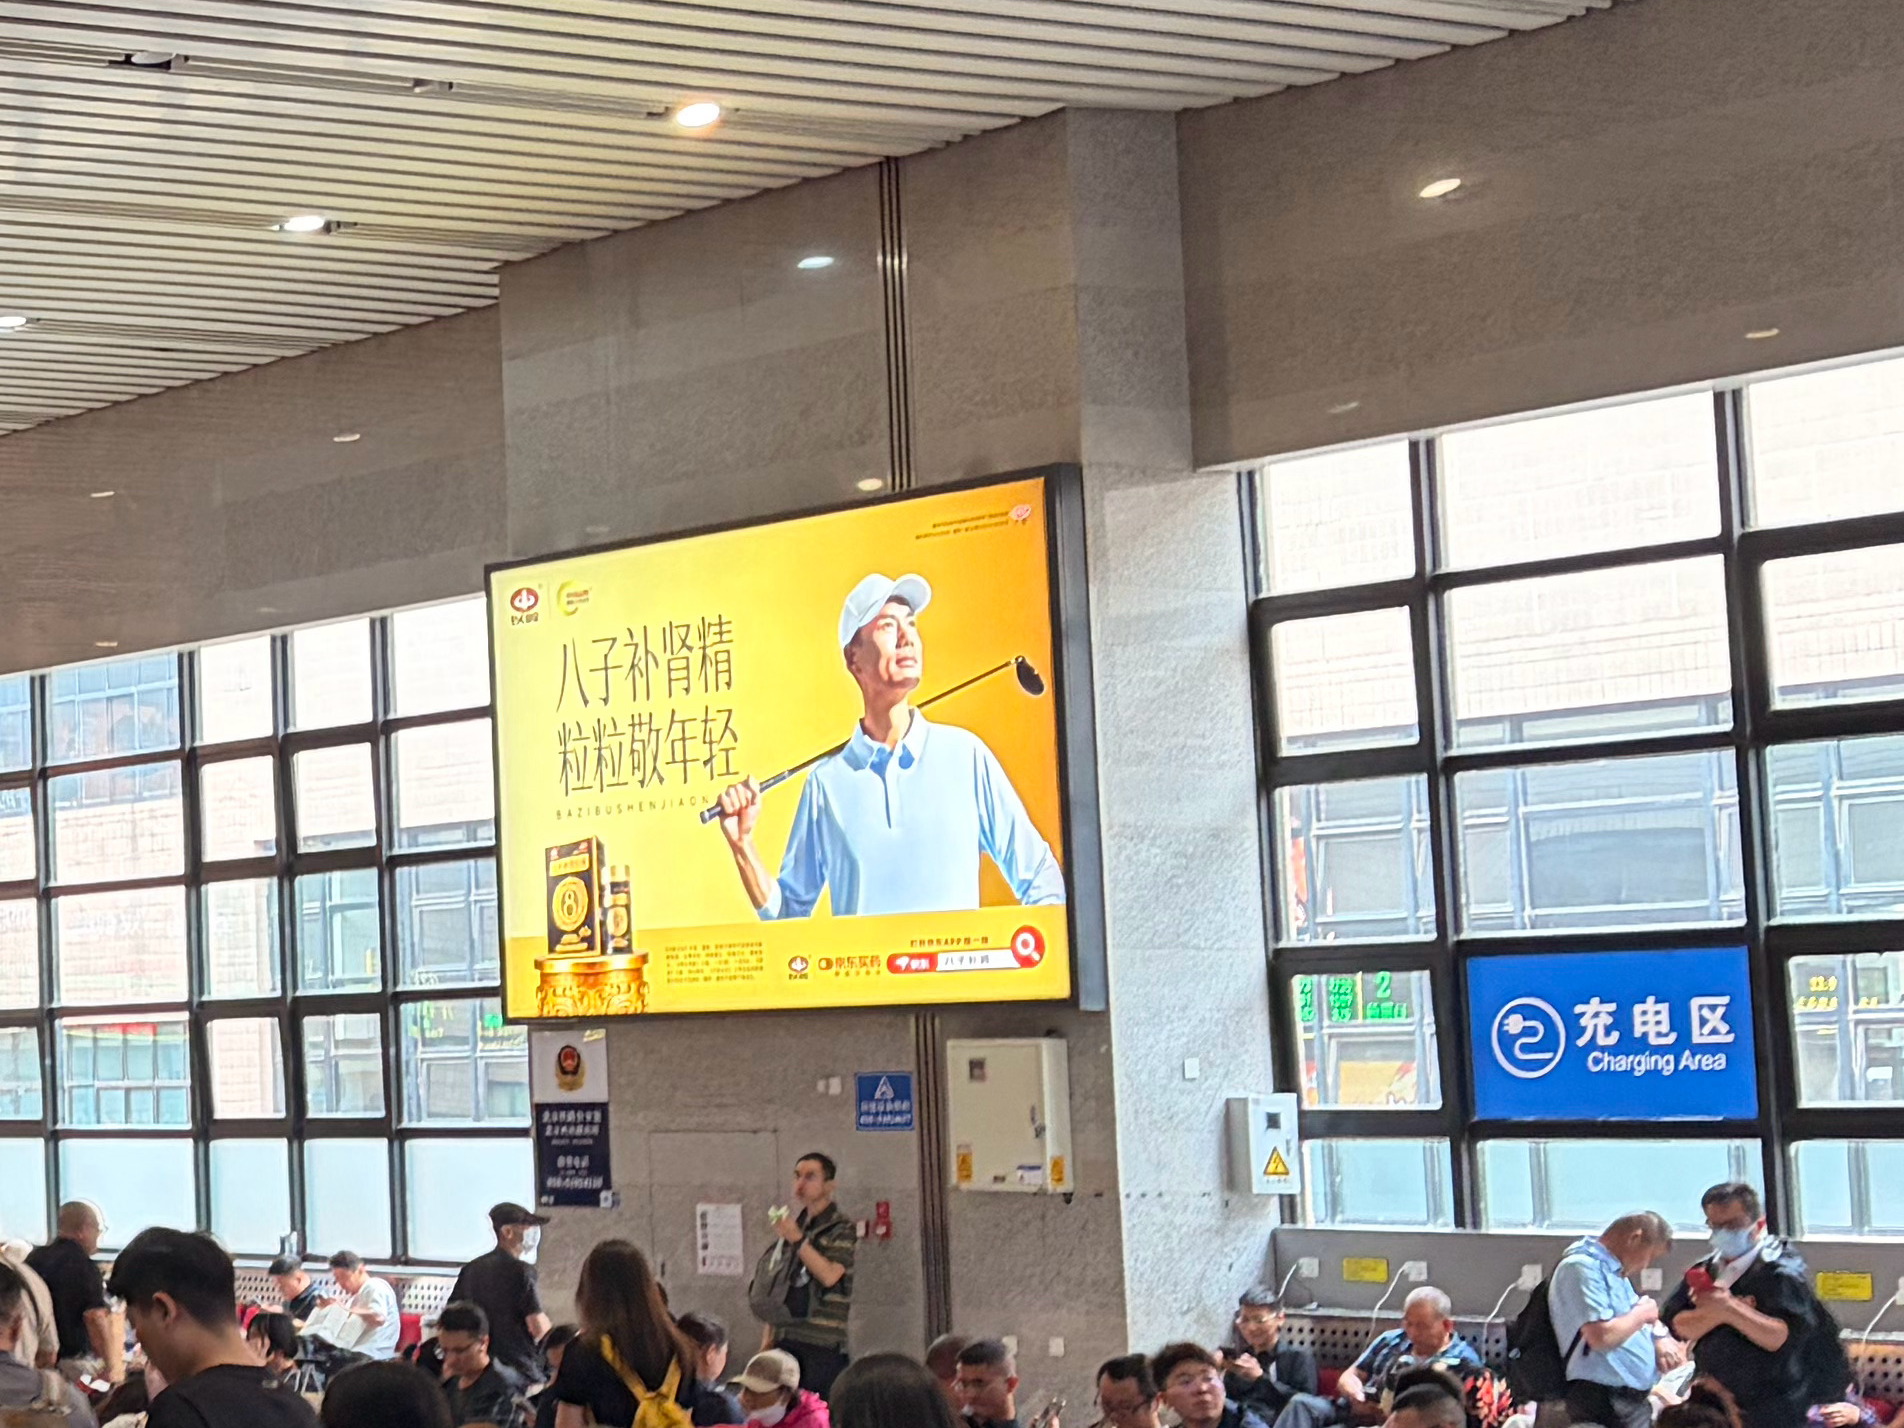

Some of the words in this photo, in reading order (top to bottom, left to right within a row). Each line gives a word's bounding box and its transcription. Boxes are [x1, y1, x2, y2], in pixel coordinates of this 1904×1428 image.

[557, 614, 734, 713] 八子补肾精
[558, 705, 740, 797] 粒粒敬年轻
[1573, 995, 1735, 1047] 充电区
[1587, 1051, 1675, 1076] Charging
[1678, 1049, 1727, 1071] Area
